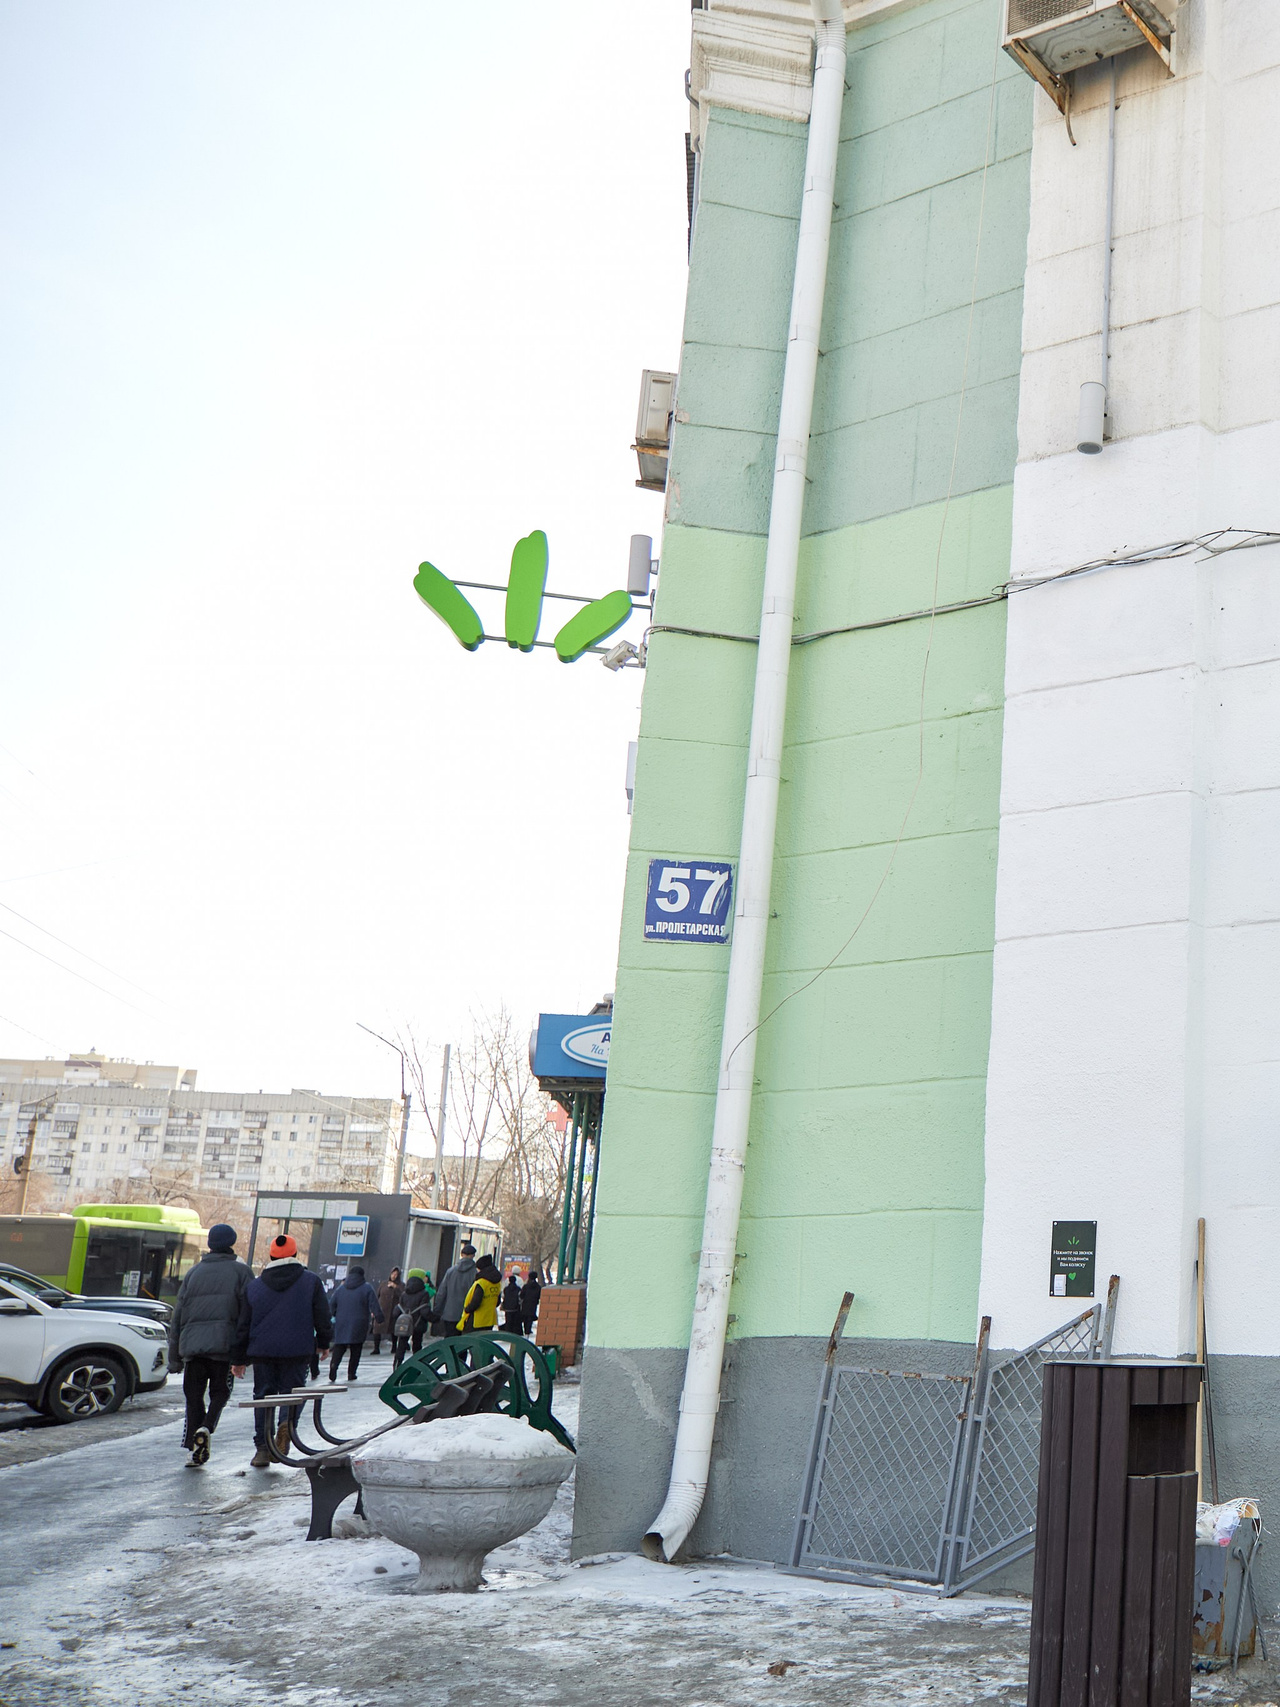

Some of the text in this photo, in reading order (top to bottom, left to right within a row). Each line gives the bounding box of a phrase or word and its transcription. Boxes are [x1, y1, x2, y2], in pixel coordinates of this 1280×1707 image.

[655, 867, 729, 915] 57
[645, 921, 727, 937] ул. ПРОЛЕТАРСКАЯ
